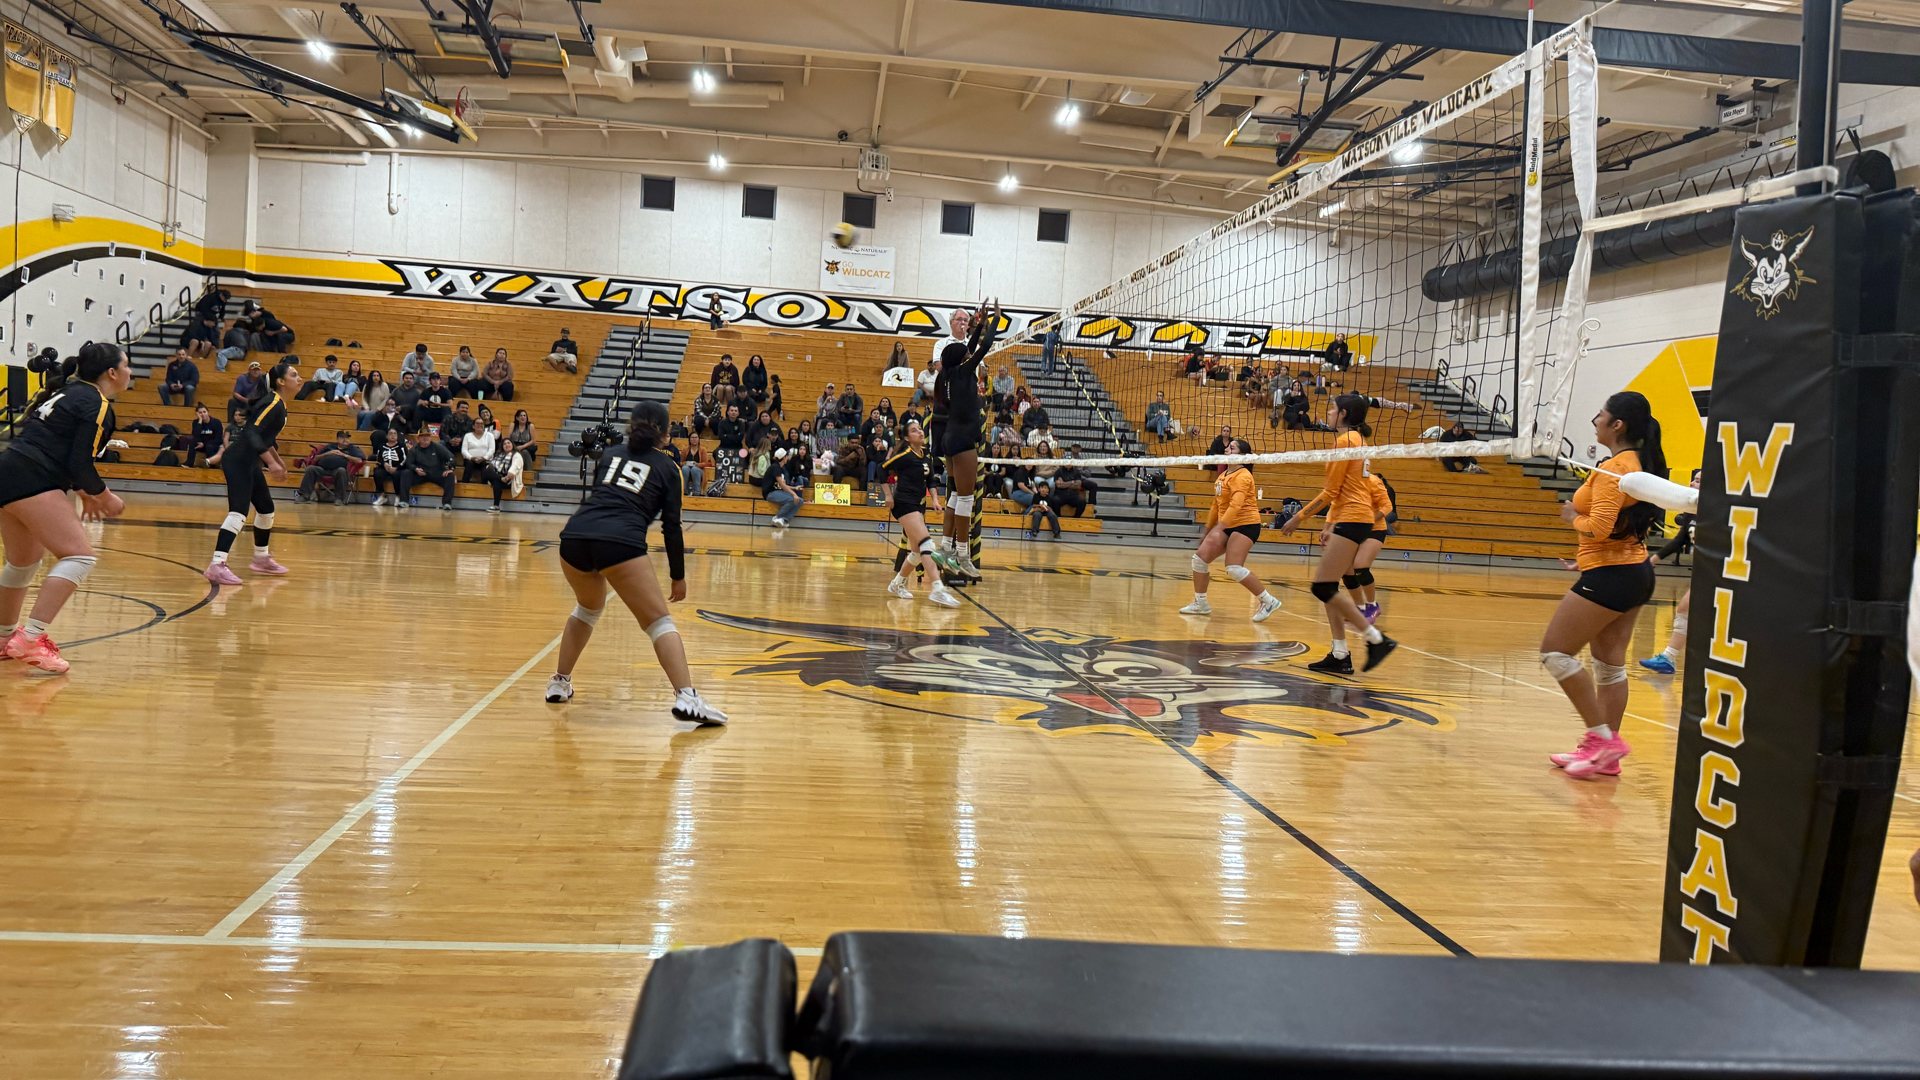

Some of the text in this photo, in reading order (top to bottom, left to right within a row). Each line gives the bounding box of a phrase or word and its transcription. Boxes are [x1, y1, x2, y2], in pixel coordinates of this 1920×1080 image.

[1341, 73, 1493, 169] WATSONVILLE WILDCATZ
[842, 268, 890, 279] WILDCATZ
[602, 456, 651, 494] 19
[1680, 421, 1795, 965] WILDCAT
